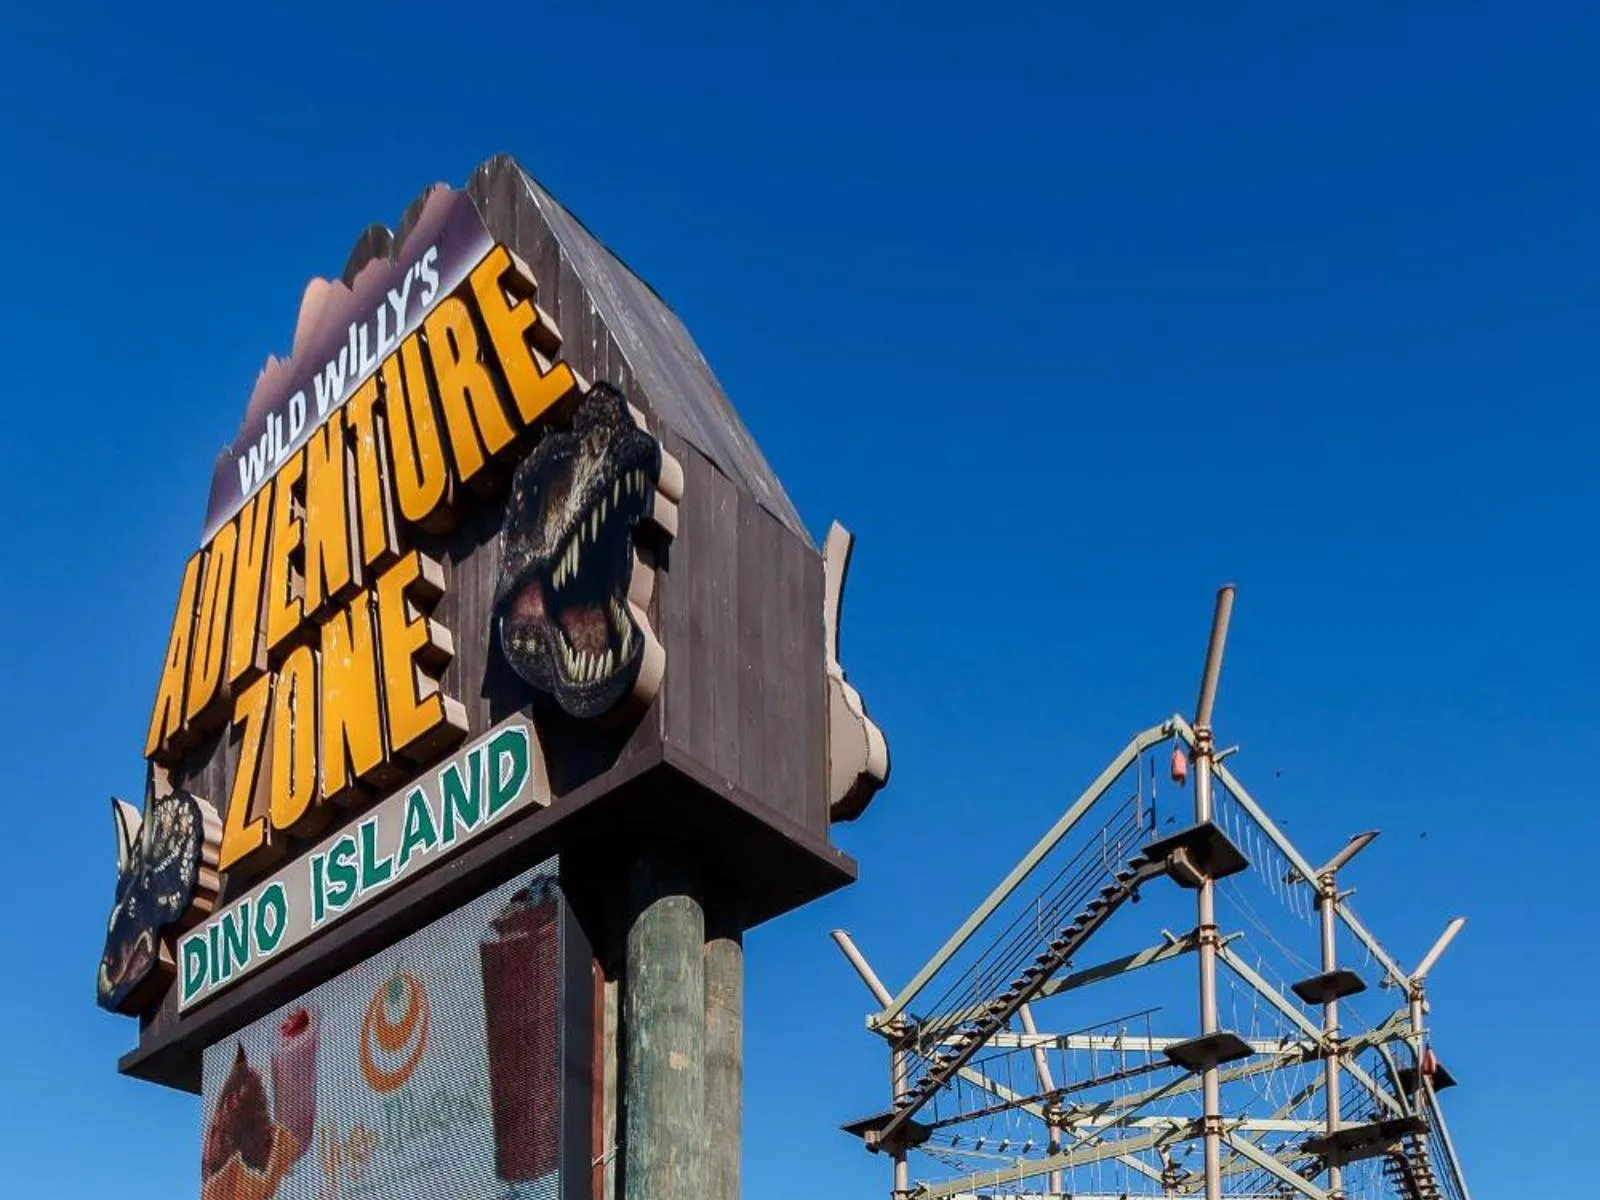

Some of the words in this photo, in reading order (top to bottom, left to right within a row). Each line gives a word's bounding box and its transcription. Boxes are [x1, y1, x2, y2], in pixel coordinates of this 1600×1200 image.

[144, 242, 575, 758] ADVENTURE
[238, 391, 306, 495] WILD
[313, 245, 440, 416] WILLY'S
[219, 551, 443, 871] ZONE
[179, 882, 287, 1008] DINO
[311, 725, 530, 929] ISLAND
